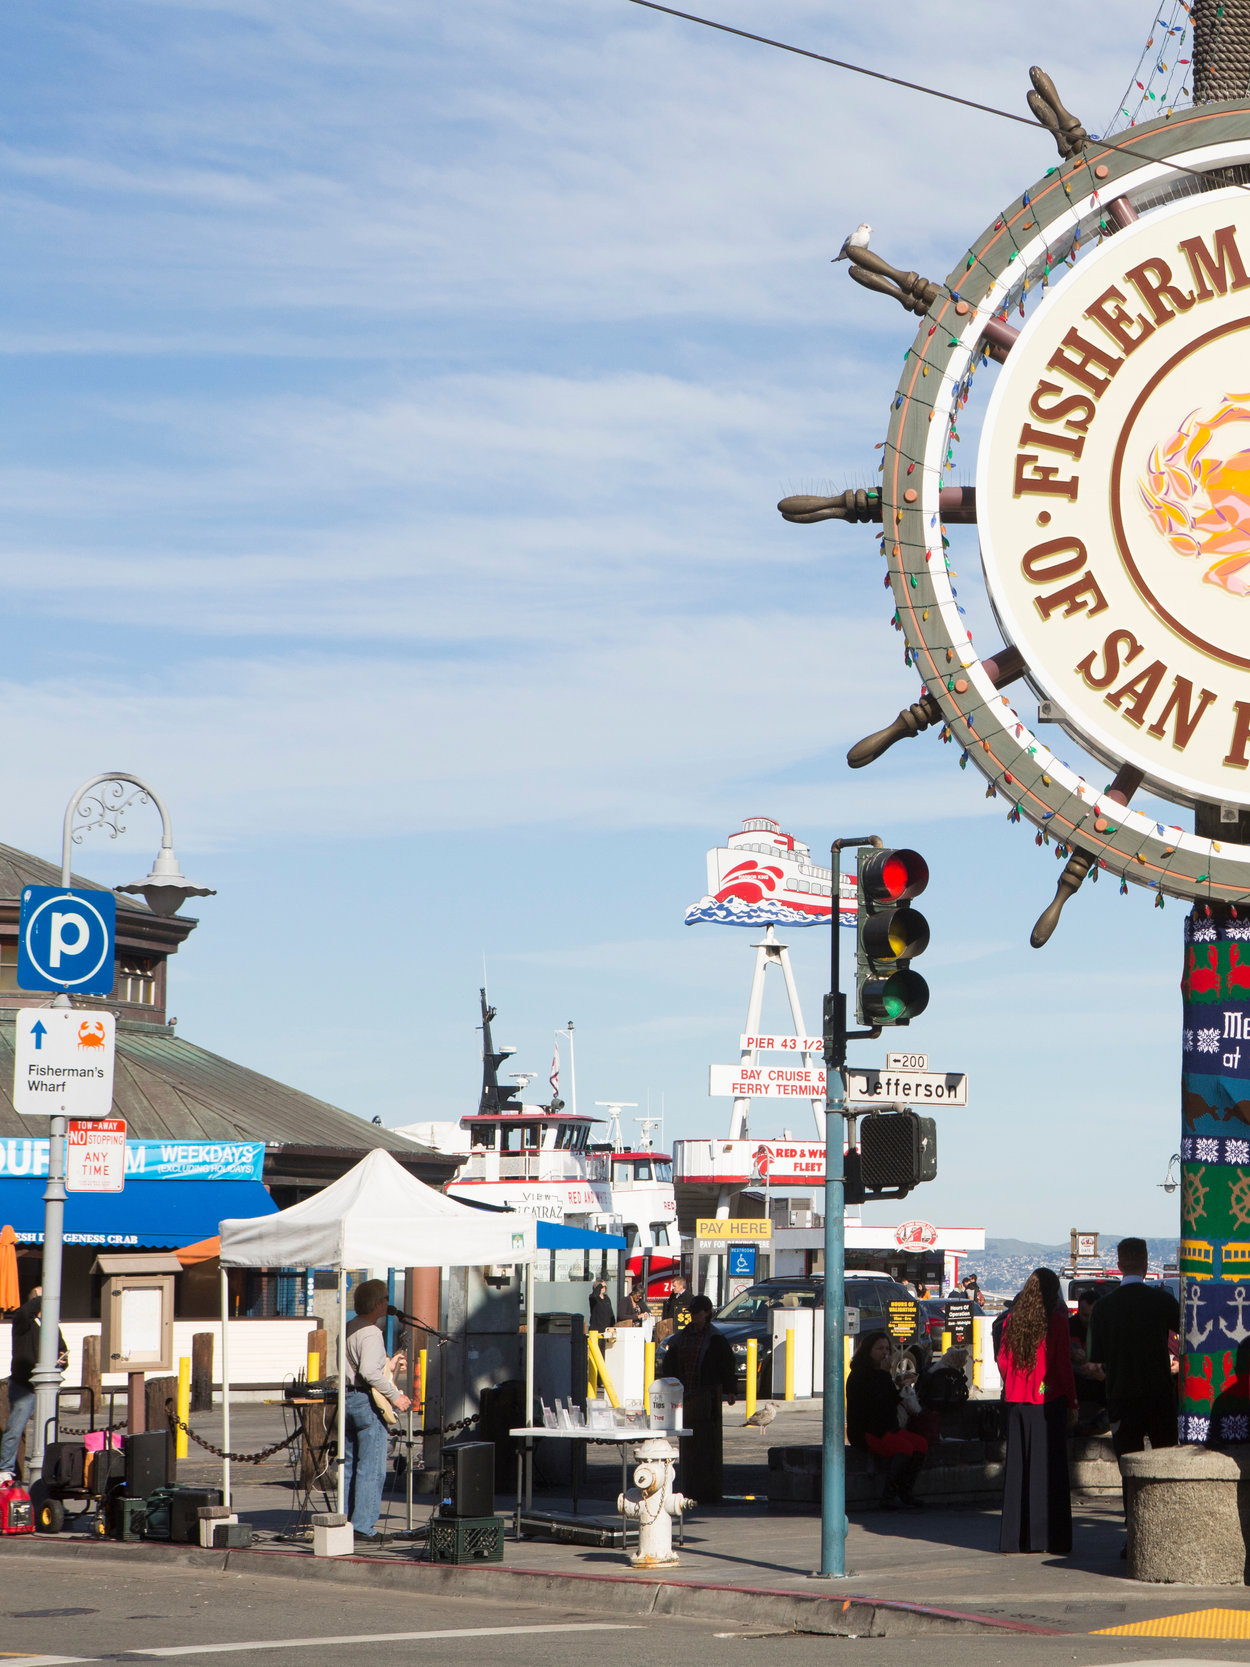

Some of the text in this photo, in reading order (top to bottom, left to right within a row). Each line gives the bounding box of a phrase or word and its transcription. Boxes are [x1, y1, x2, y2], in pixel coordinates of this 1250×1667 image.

[1022, 536, 1107, 620] OF
[1076, 629, 1216, 750] SAN
[747, 1037, 823, 1051] PIER 43 1/2
[902, 1055, 925, 1068] 200
[1223, 1046, 1241, 1069] at
[28, 1064, 104, 1079] Fisherman's
[740, 1069, 826, 1083] BAY CRUISE &
[27, 1079, 67, 1093] Wharf
[732, 1082, 827, 1096] FERRY TERMINA
[858, 1076, 958, 1099] Jefferson
[77, 1121, 118, 1131] TOW-AWAY
[70, 1130, 124, 1145] NO STOPPING
[84, 1152, 108, 1162] ANY
[161, 1145, 254, 1163] WEEKDAYS
[775, 1148, 797, 1158] RED
[799, 1148, 807, 1158] &
[82, 1165, 110, 1176] TIME
[158, 1164, 255, 1175] (EXCLUDING HOLIDAYS)
[793, 1162, 822, 1173] FLEET
[522, 1191, 551, 1201] VIEW
[567, 1191, 581, 1204] RED
[663, 1201, 675, 1210] RED
[700, 1222, 767, 1234] PAY HERE
[15, 1233, 37, 1242] ESH
[107, 1234, 139, 1244] CRAB
[699, 1240, 711, 1249] PAY
[713, 1240, 726, 1249] FOR
